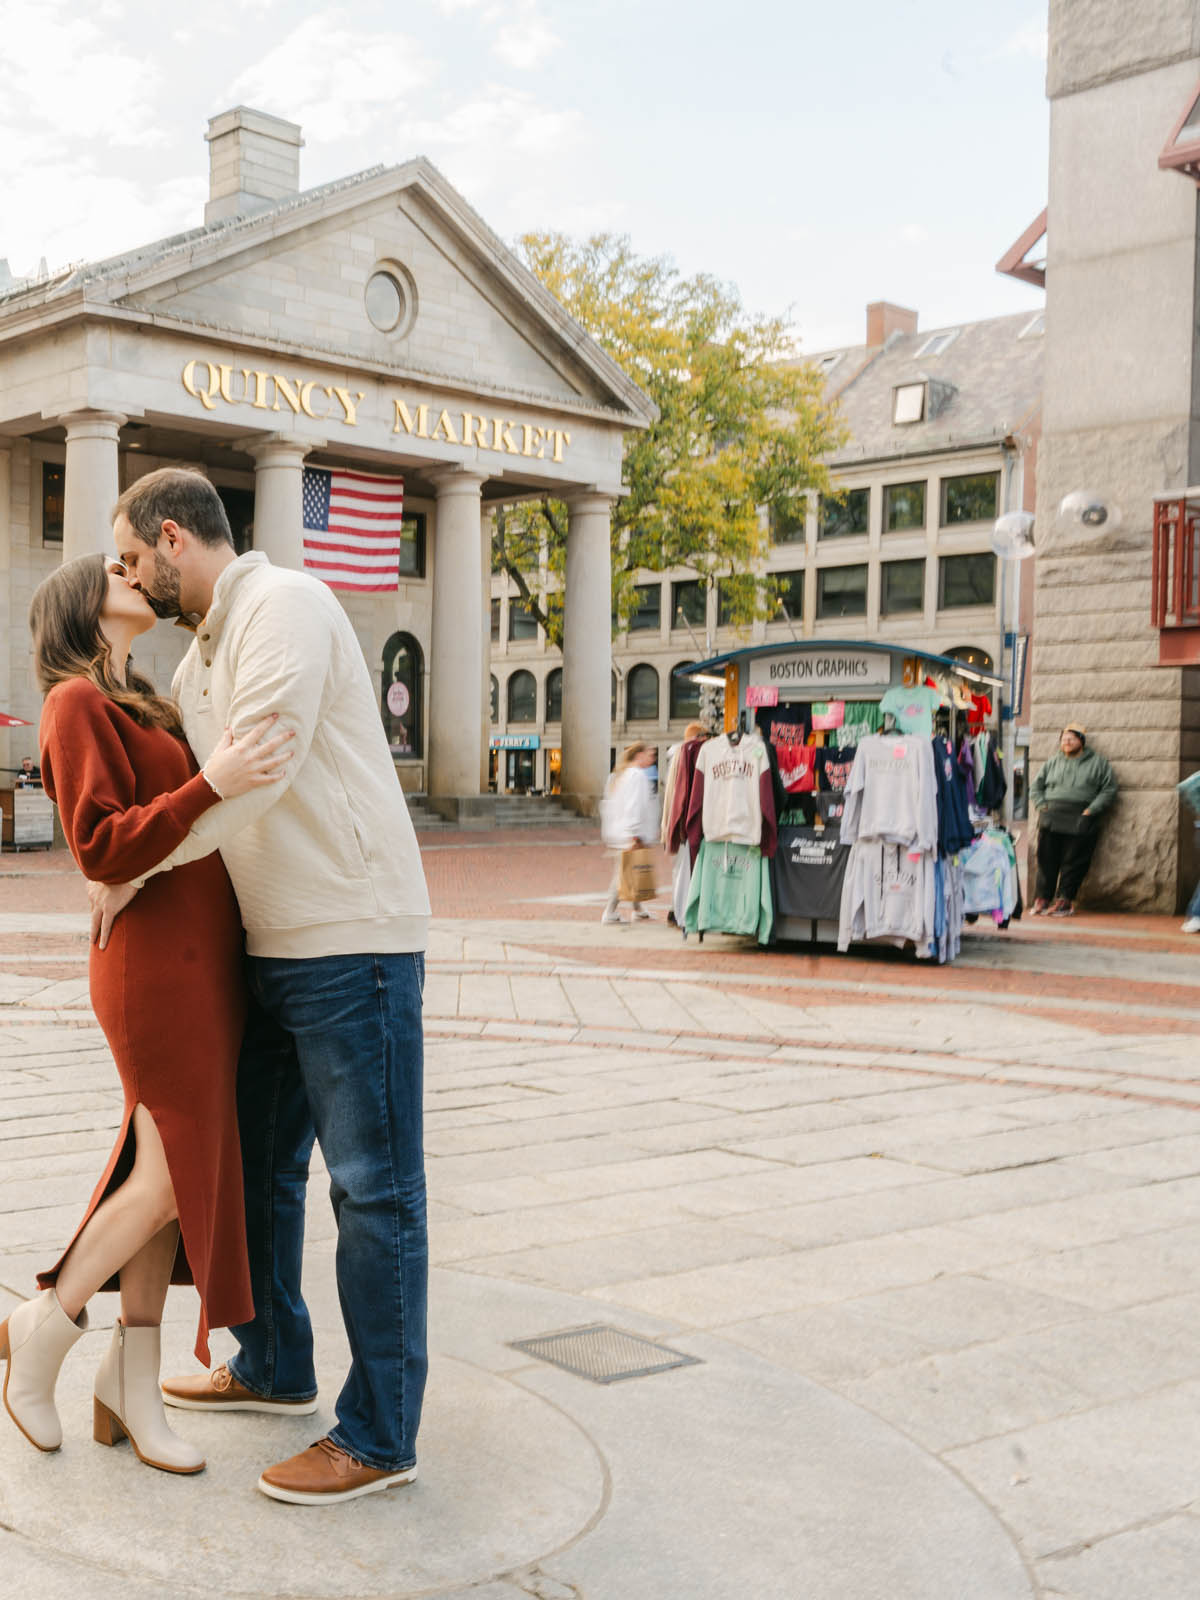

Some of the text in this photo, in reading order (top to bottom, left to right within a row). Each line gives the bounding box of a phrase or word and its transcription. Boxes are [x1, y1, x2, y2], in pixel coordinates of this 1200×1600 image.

[182, 359, 571, 463] QUINCY MARKET
[770, 658, 868, 680] BOSTON GRAPHICS
